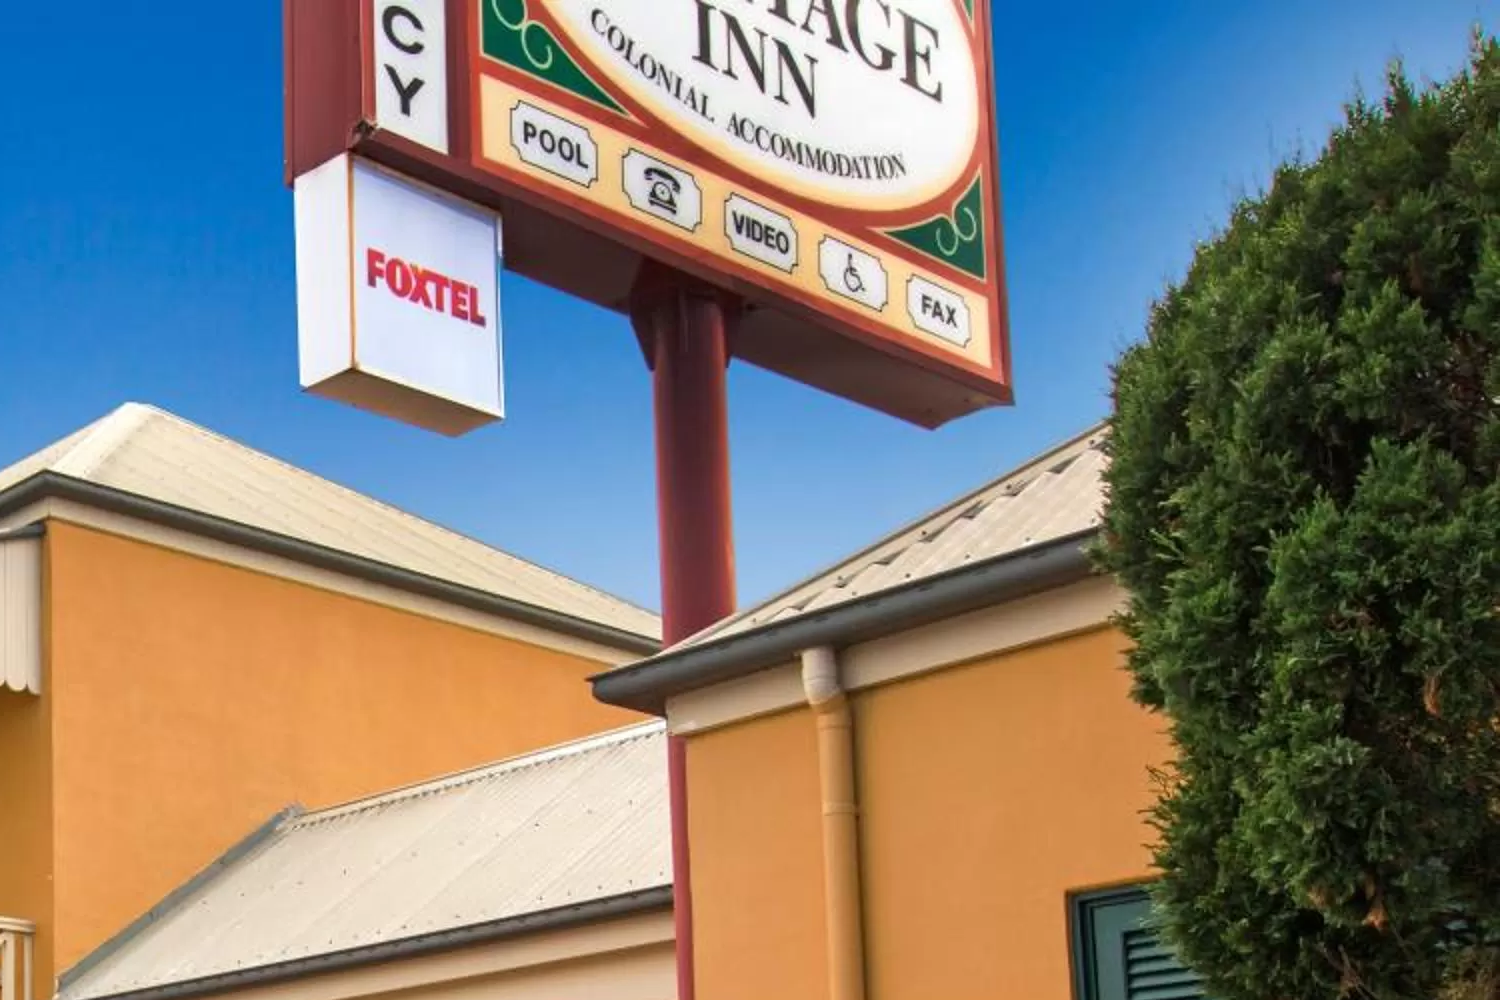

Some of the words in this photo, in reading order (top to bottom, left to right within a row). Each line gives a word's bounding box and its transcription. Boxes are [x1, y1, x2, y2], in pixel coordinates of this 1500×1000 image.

[692, 0, 818, 119] INN
[767, 0, 942, 103] AGE
[590, 8, 715, 122] COLONIAL
[727, 112, 907, 180] ACCOMMODATION
[523, 121, 589, 169] POOL
[731, 210, 790, 255] VIDEO
[367, 248, 486, 328] FOXTEL
[921, 294, 958, 327] FAX
